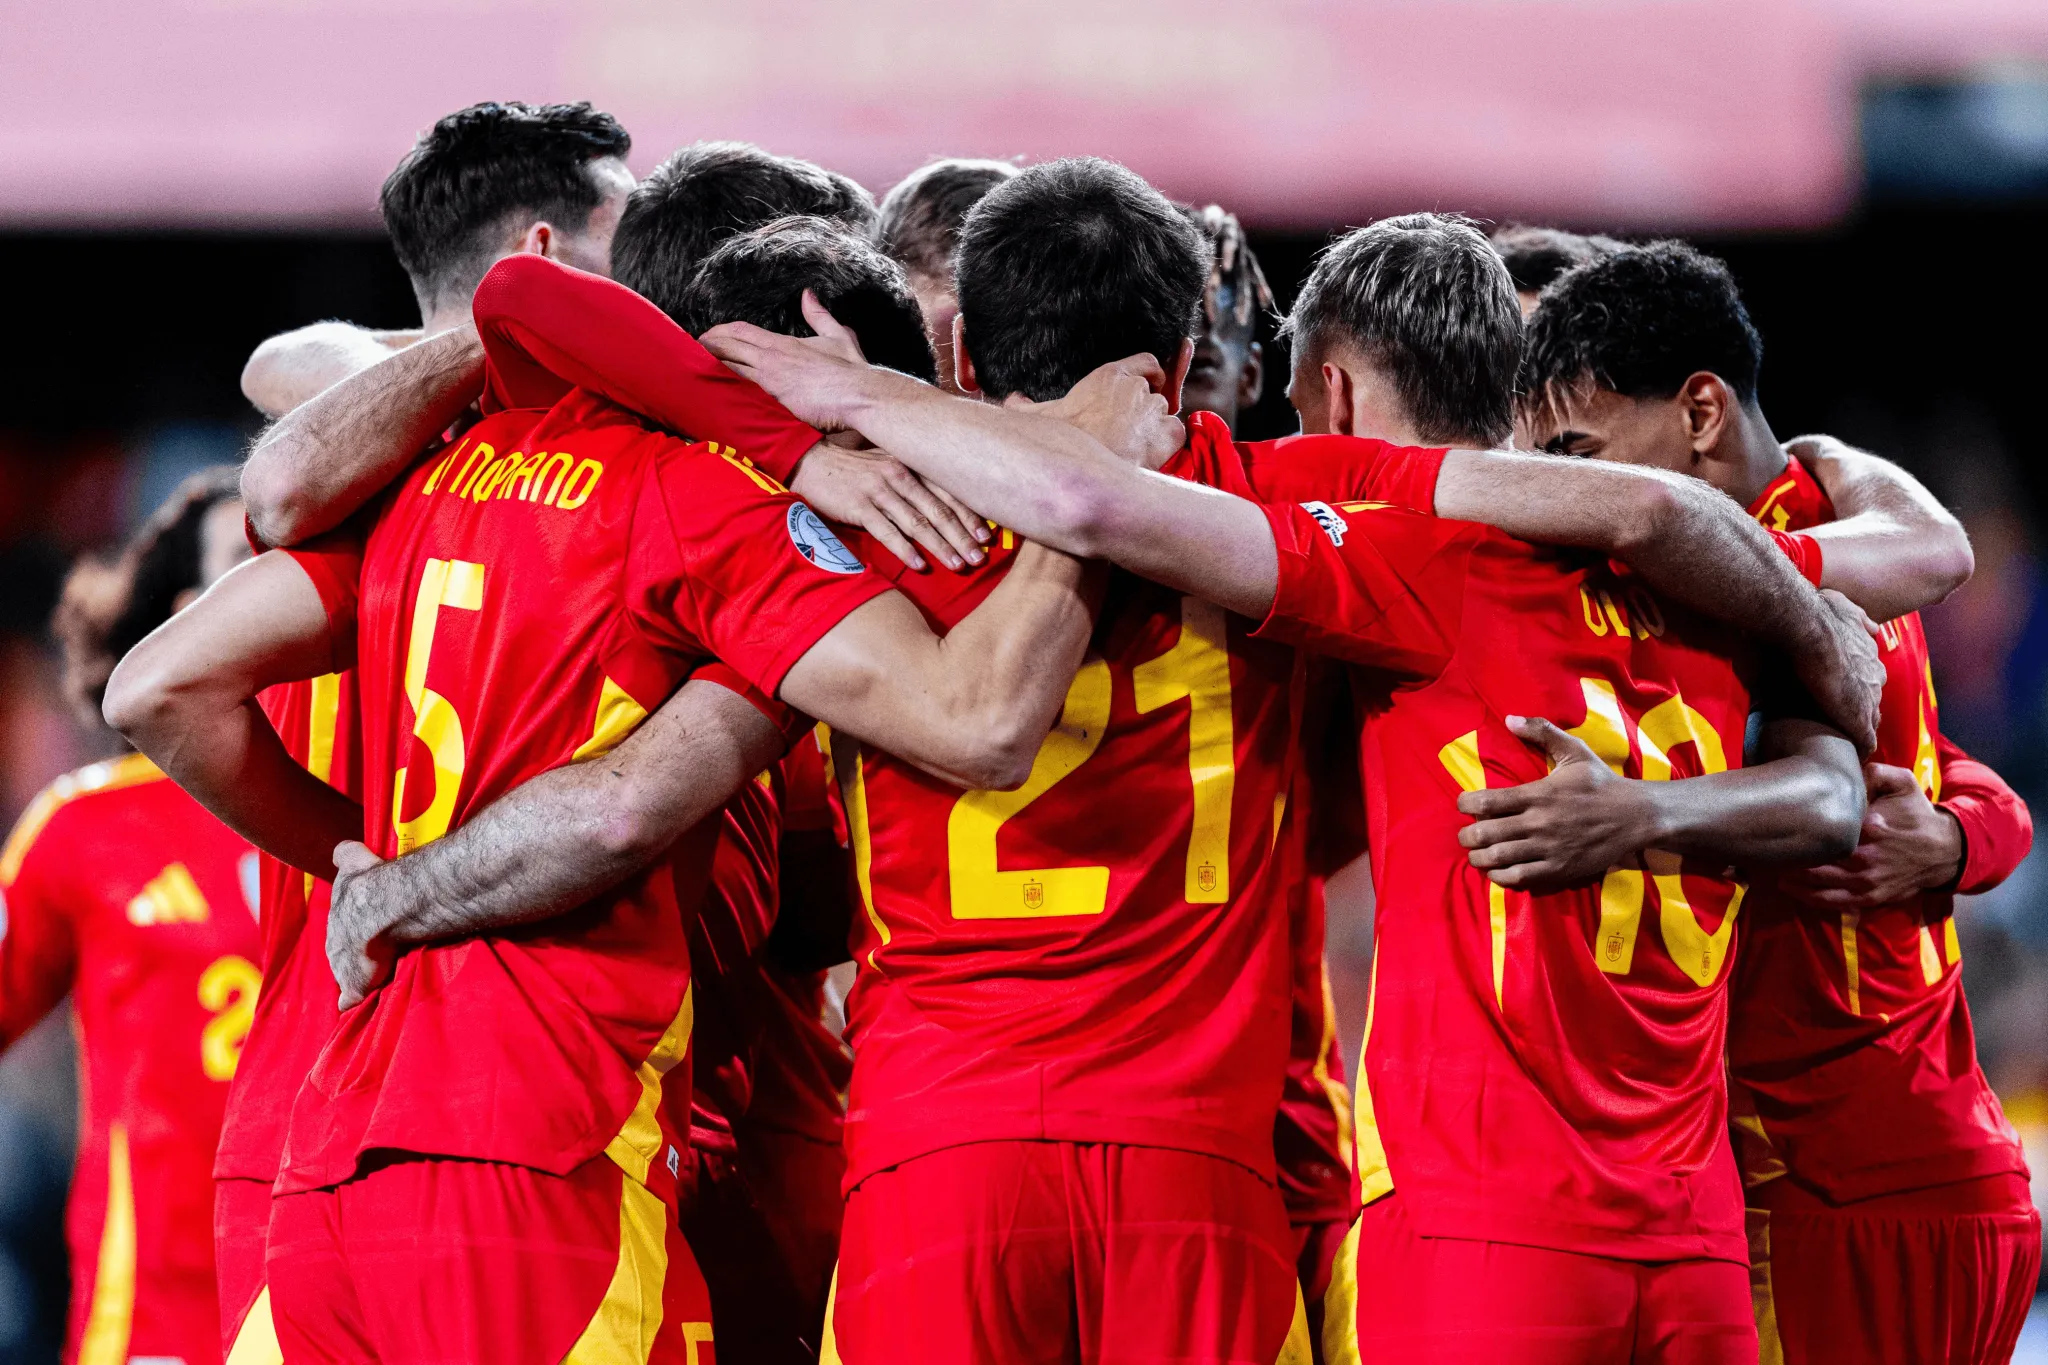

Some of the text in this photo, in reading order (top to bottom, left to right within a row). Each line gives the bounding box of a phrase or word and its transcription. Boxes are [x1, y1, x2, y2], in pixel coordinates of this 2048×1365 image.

[392, 557, 485, 860] 5
[947, 596, 1235, 919] 21
[1547, 676, 1750, 988] 10
[197, 954, 264, 1082] 2
